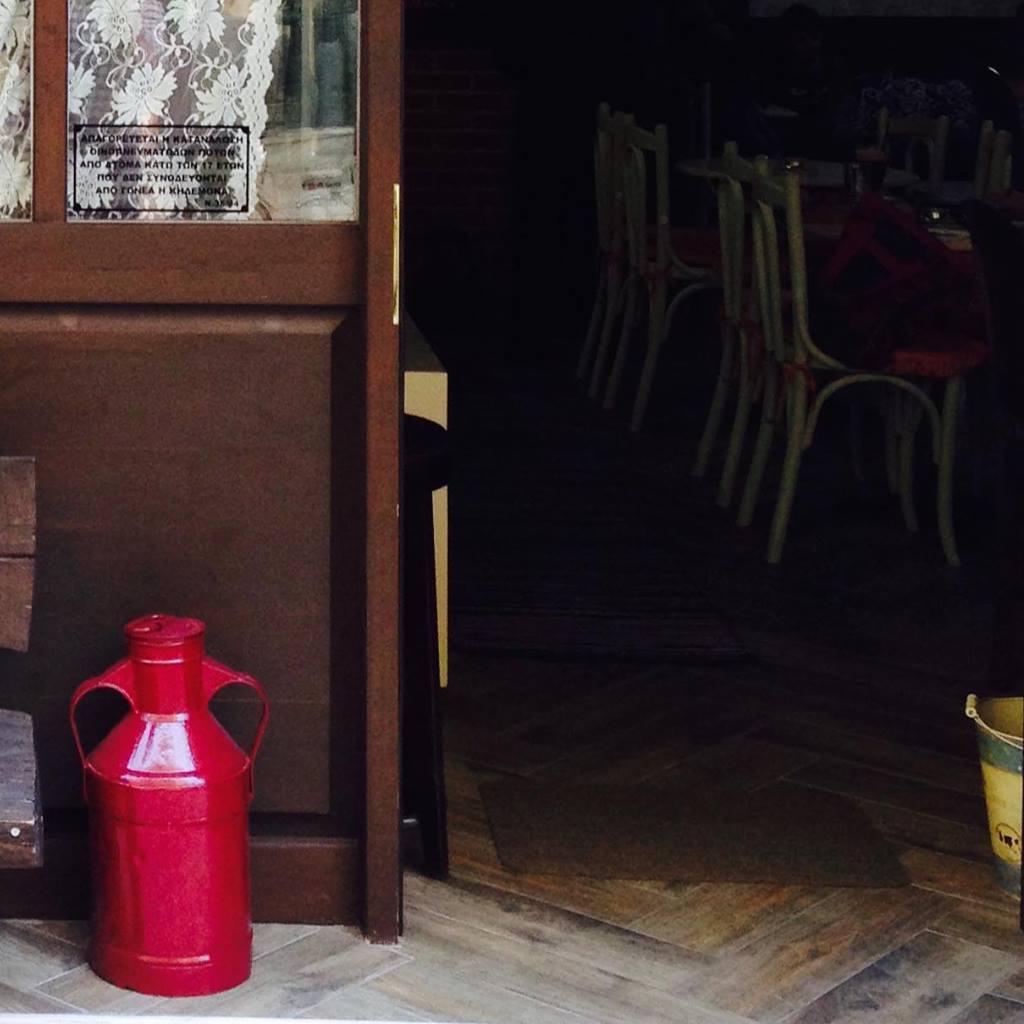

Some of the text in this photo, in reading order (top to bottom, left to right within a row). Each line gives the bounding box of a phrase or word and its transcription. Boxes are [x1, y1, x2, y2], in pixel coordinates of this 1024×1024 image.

[80, 161, 102, 169] ΑΠΟ
[105, 161, 141, 170] ΑΤΟΜΑ
[177, 162, 198, 170] ΤΩΝ
[97, 174, 118, 182] ΠΟΥ
[122, 174, 143, 182] ΔΕΝ
[95, 187, 118, 195] ΑΠΟ
[158, 187, 165, 195] Η
